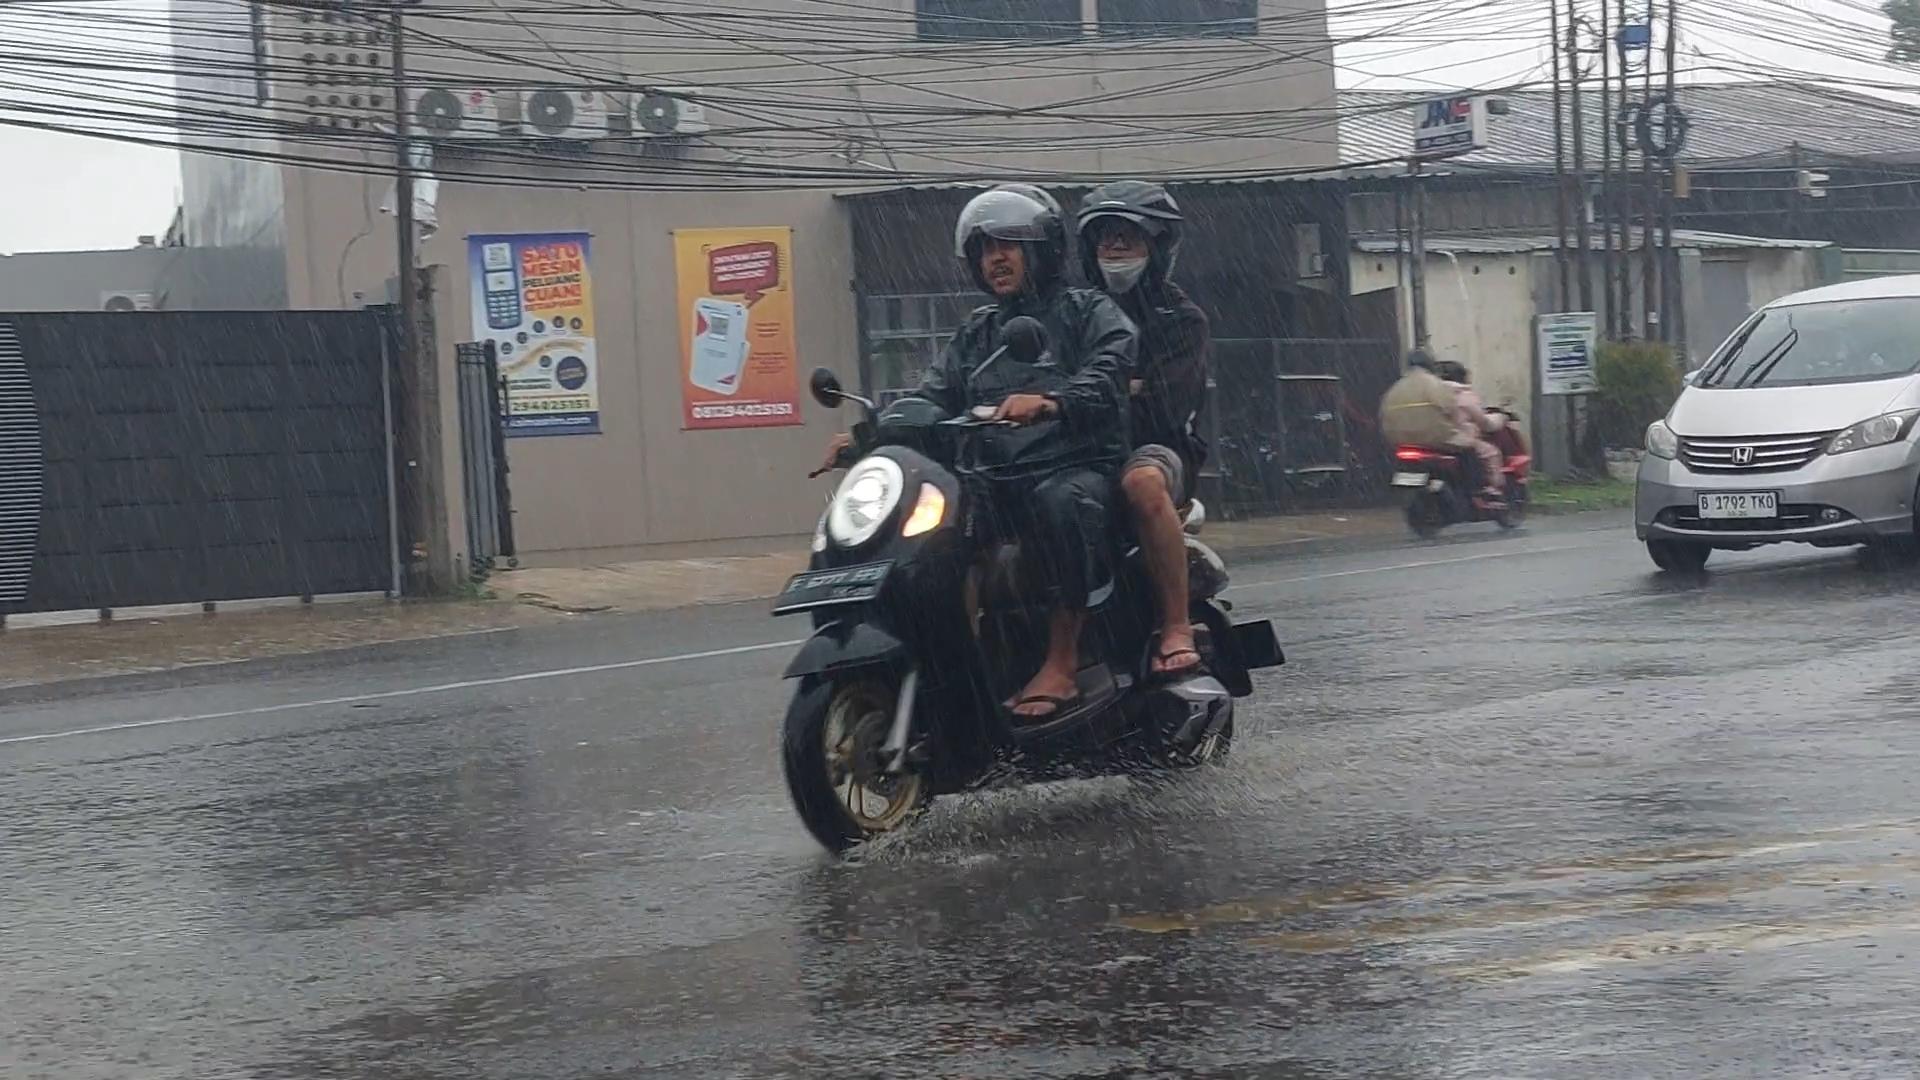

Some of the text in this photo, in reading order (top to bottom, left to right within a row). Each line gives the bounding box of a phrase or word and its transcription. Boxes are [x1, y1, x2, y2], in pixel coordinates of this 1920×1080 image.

[521, 243, 581, 263] SATU
[522, 259, 581, 277] MESIN
[1701, 496, 1709, 510] B
[1715, 495, 1746, 510] 1792
